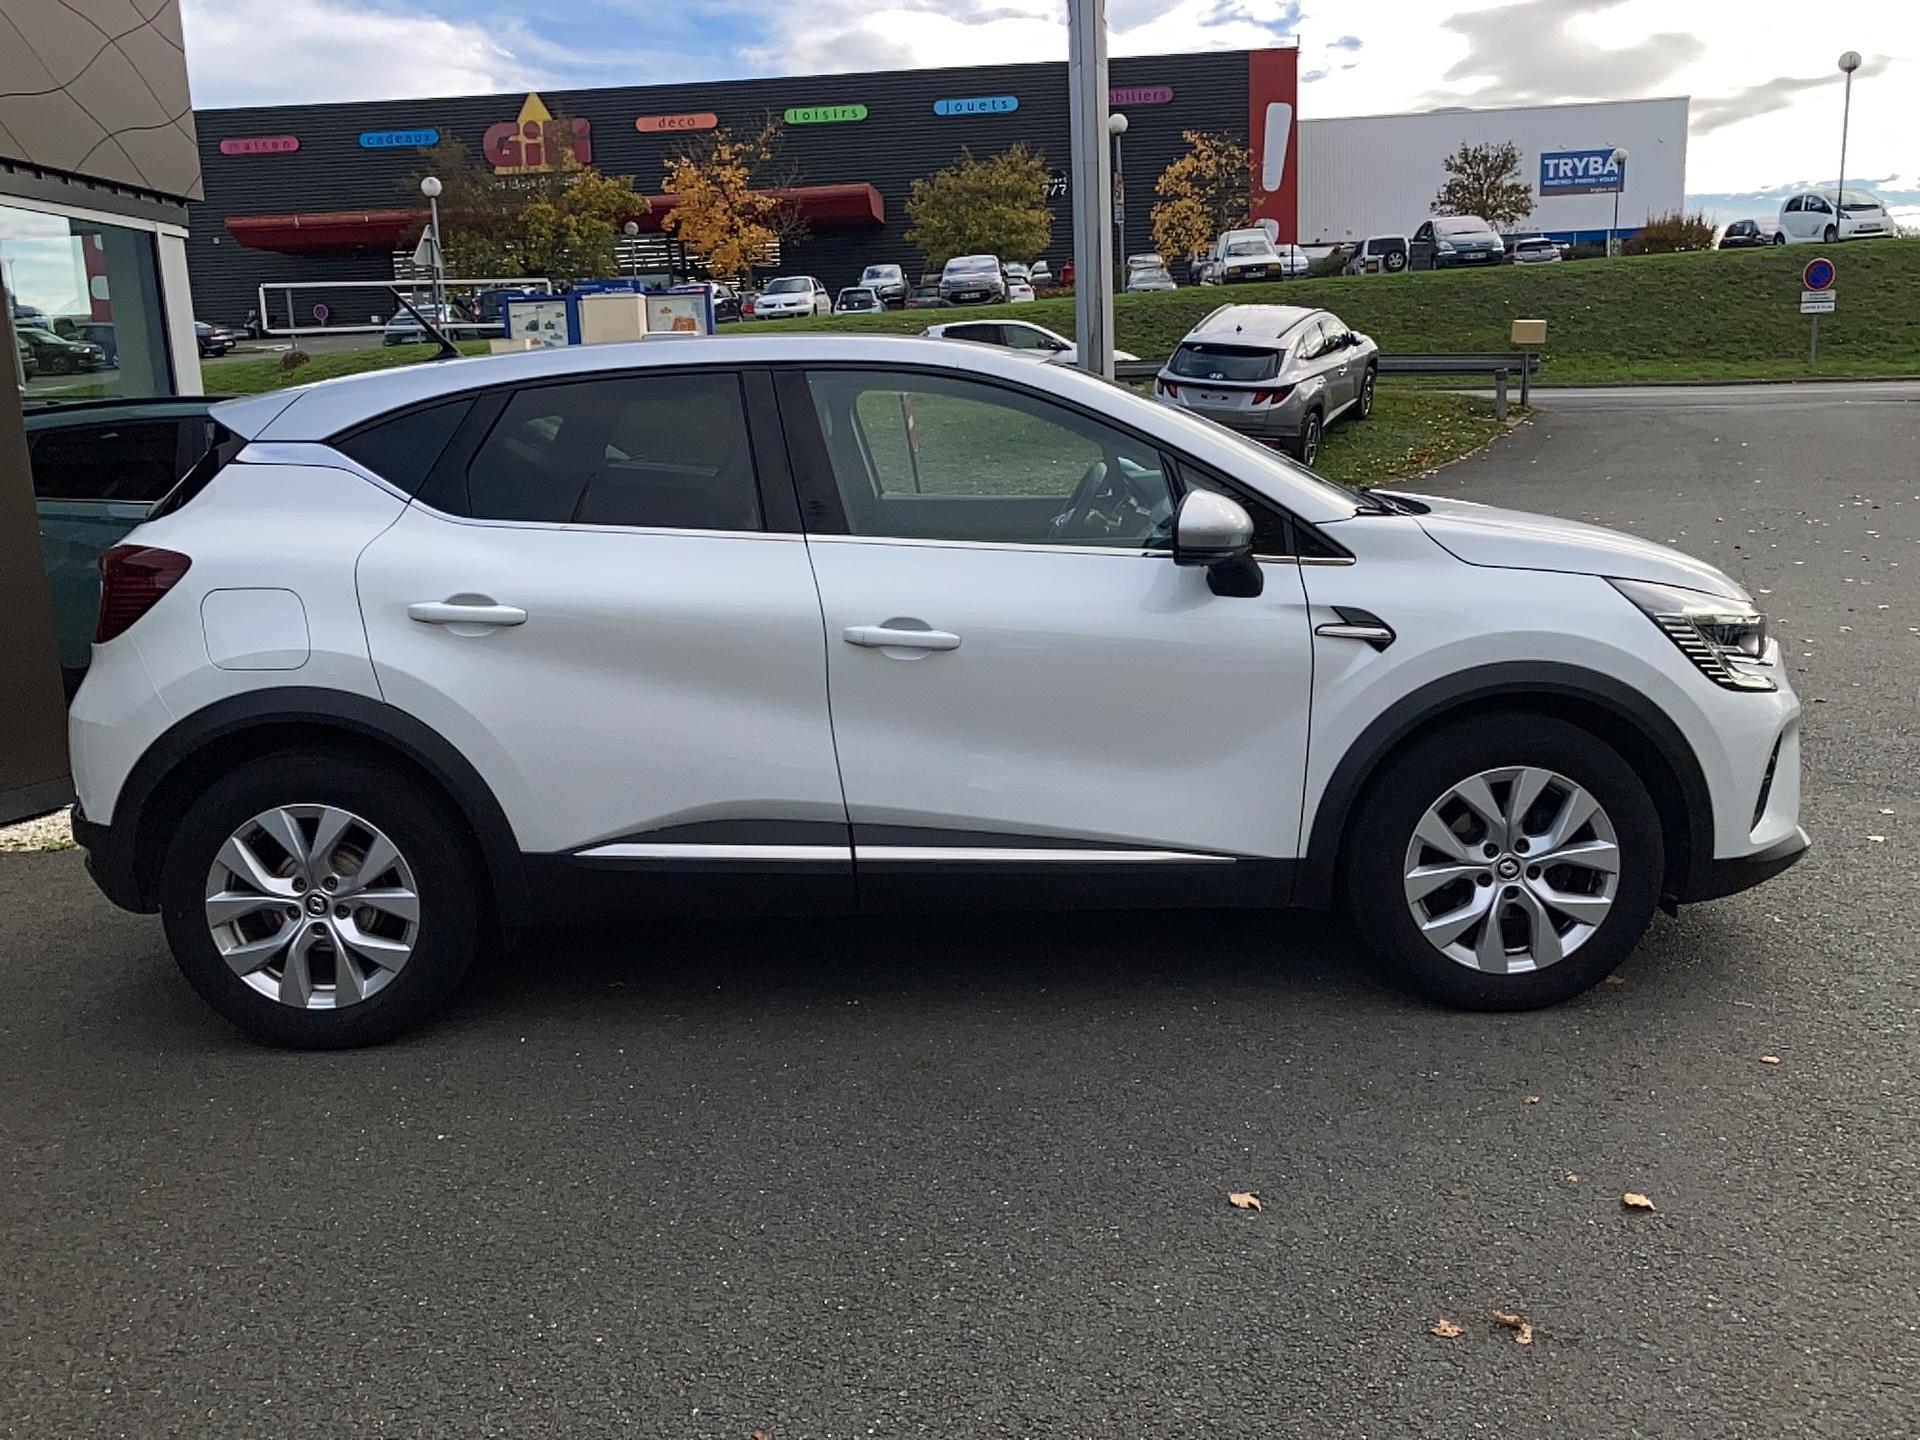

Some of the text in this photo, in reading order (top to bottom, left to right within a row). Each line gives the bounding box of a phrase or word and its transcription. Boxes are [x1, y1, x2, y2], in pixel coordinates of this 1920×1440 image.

[945, 99, 1008, 113] jouets
[793, 108, 858, 121] loisirs
[229, 140, 290, 152] maison
[367, 134, 432, 145] cadeaux
[1544, 156, 1618, 178] TRYBA
